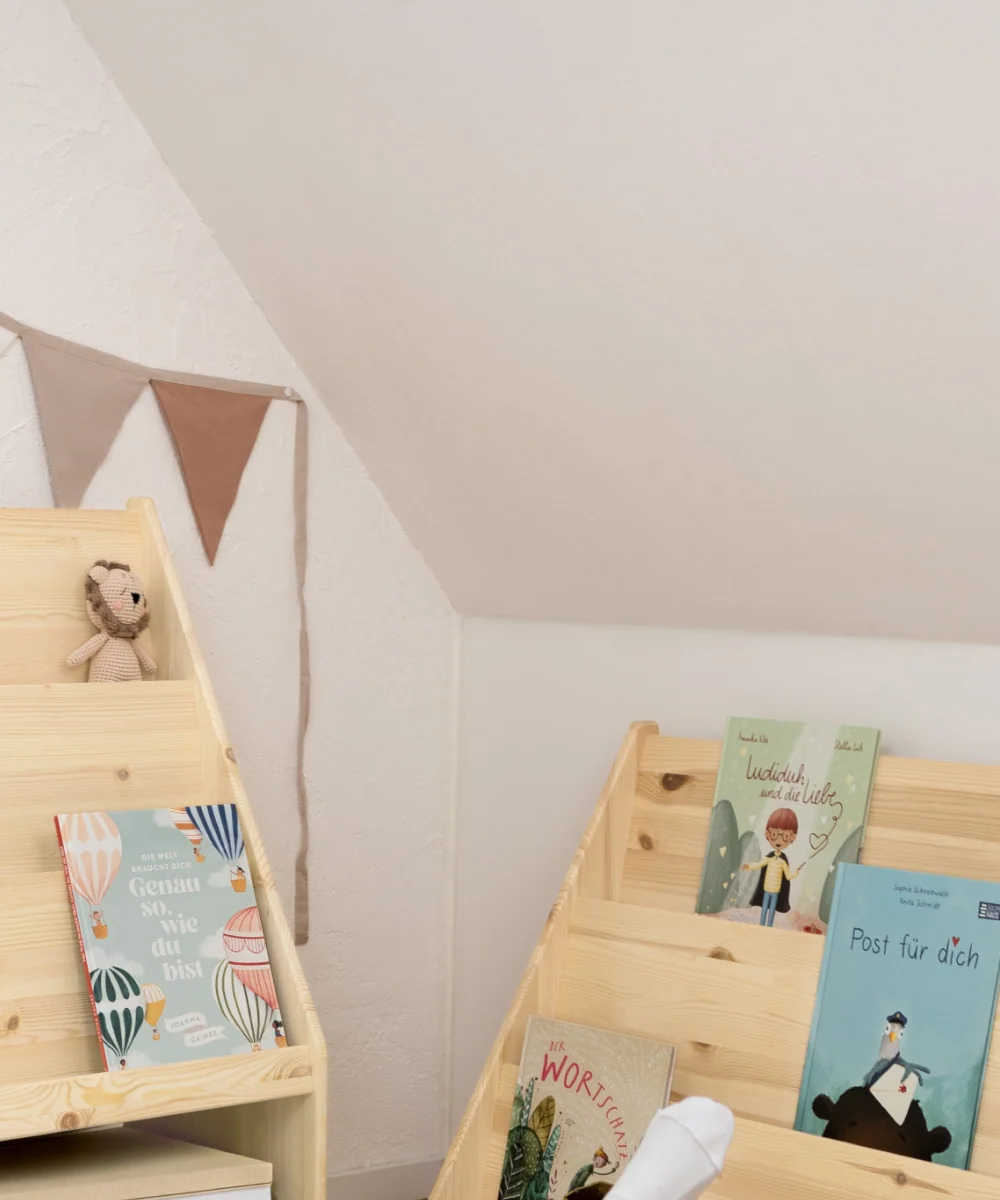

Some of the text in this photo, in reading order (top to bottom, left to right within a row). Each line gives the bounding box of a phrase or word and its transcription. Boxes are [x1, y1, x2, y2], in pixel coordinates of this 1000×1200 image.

[746, 754, 805, 785] Ludiduh
[759, 779, 837, 805] und die Liebe
[131, 861, 192, 873] BRAUCHT DICH
[141, 852, 178, 862] DIE WELT
[129, 875, 201, 897] Genau
[160, 914, 199, 936] wie
[151, 937, 182, 957] du
[851, 927, 980, 970] Post für dich
[162, 960, 204, 981] bist
[171, 1016, 201, 1029] JOANNA
[190, 1030, 217, 1043] GAINES
[549, 1041, 566, 1052] DER
[540, 1053, 629, 1161] WORTSCHATZ
